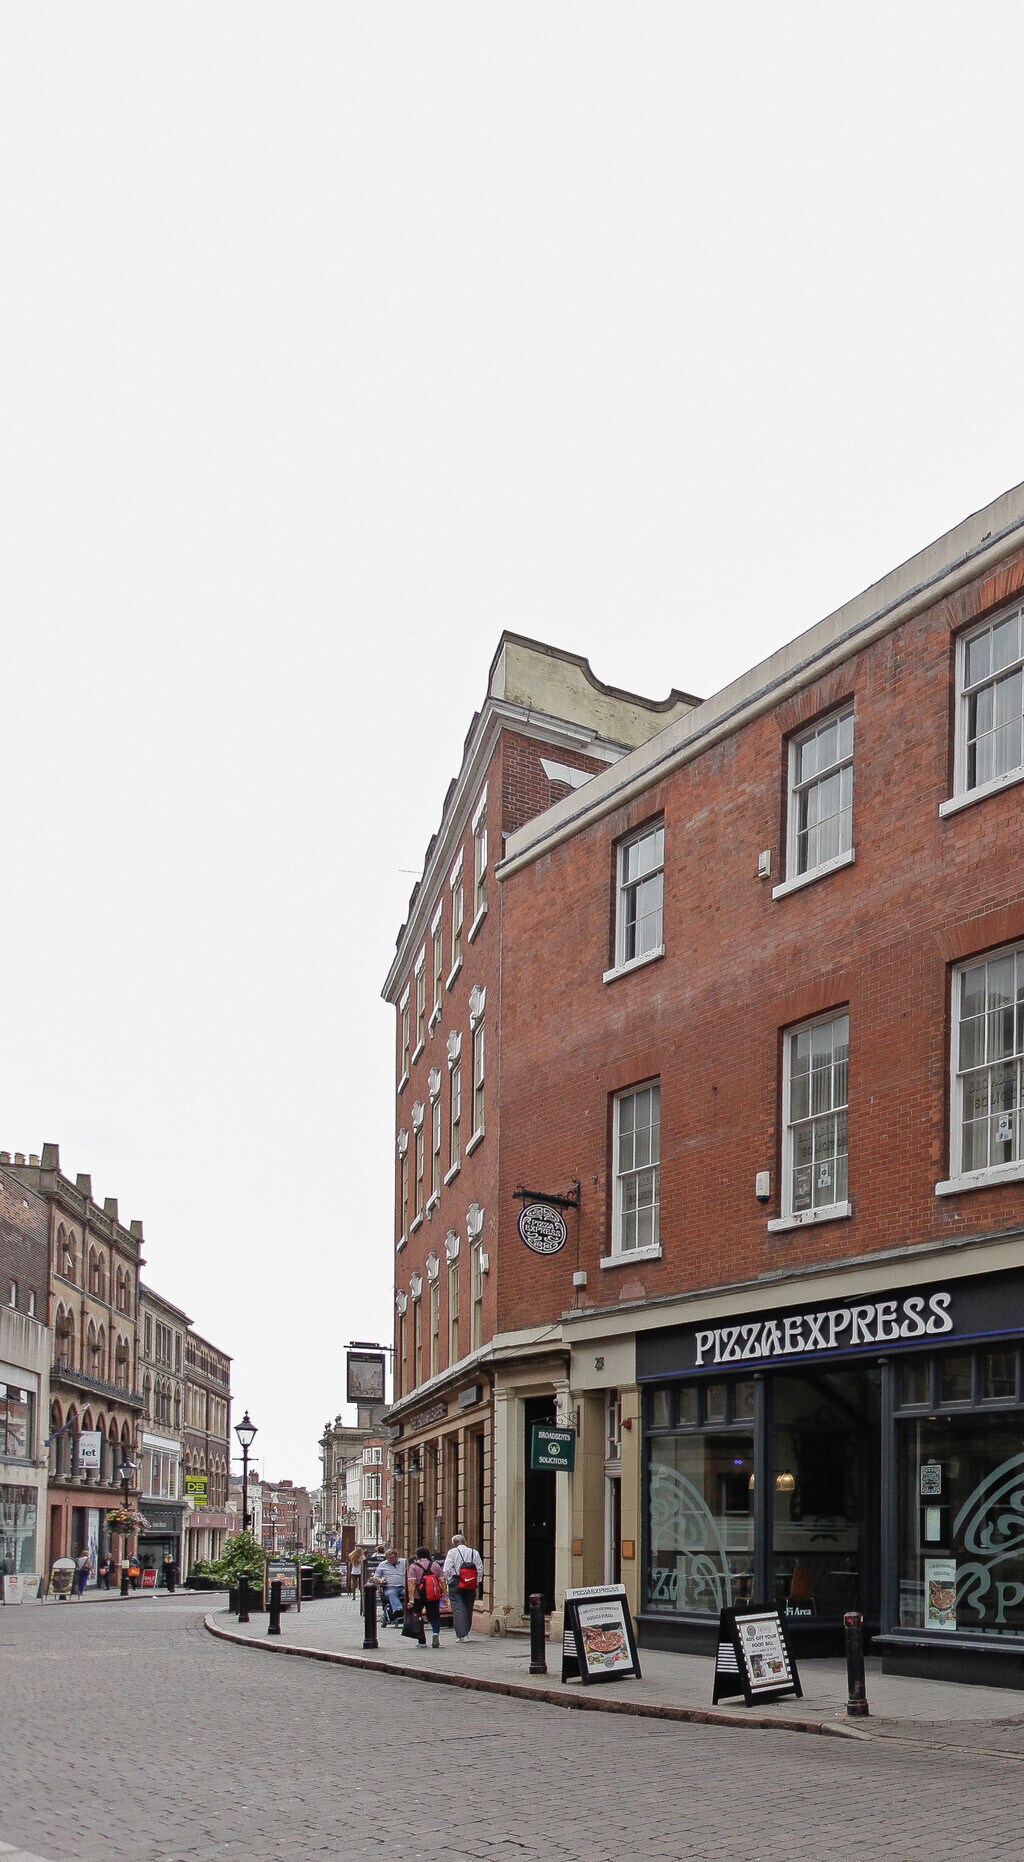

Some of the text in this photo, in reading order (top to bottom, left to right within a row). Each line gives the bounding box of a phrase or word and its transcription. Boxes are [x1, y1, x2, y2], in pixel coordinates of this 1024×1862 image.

[531, 1219, 555, 1230] PIZZA
[525, 1224, 561, 1237] EXPRESS
[695, 1292, 954, 1366] PIZZAEXPRESS
[538, 1431, 571, 1441] BROADBENTS
[82, 1448, 97, 1457] let
[539, 1455, 568, 1465] SOLICITORS
